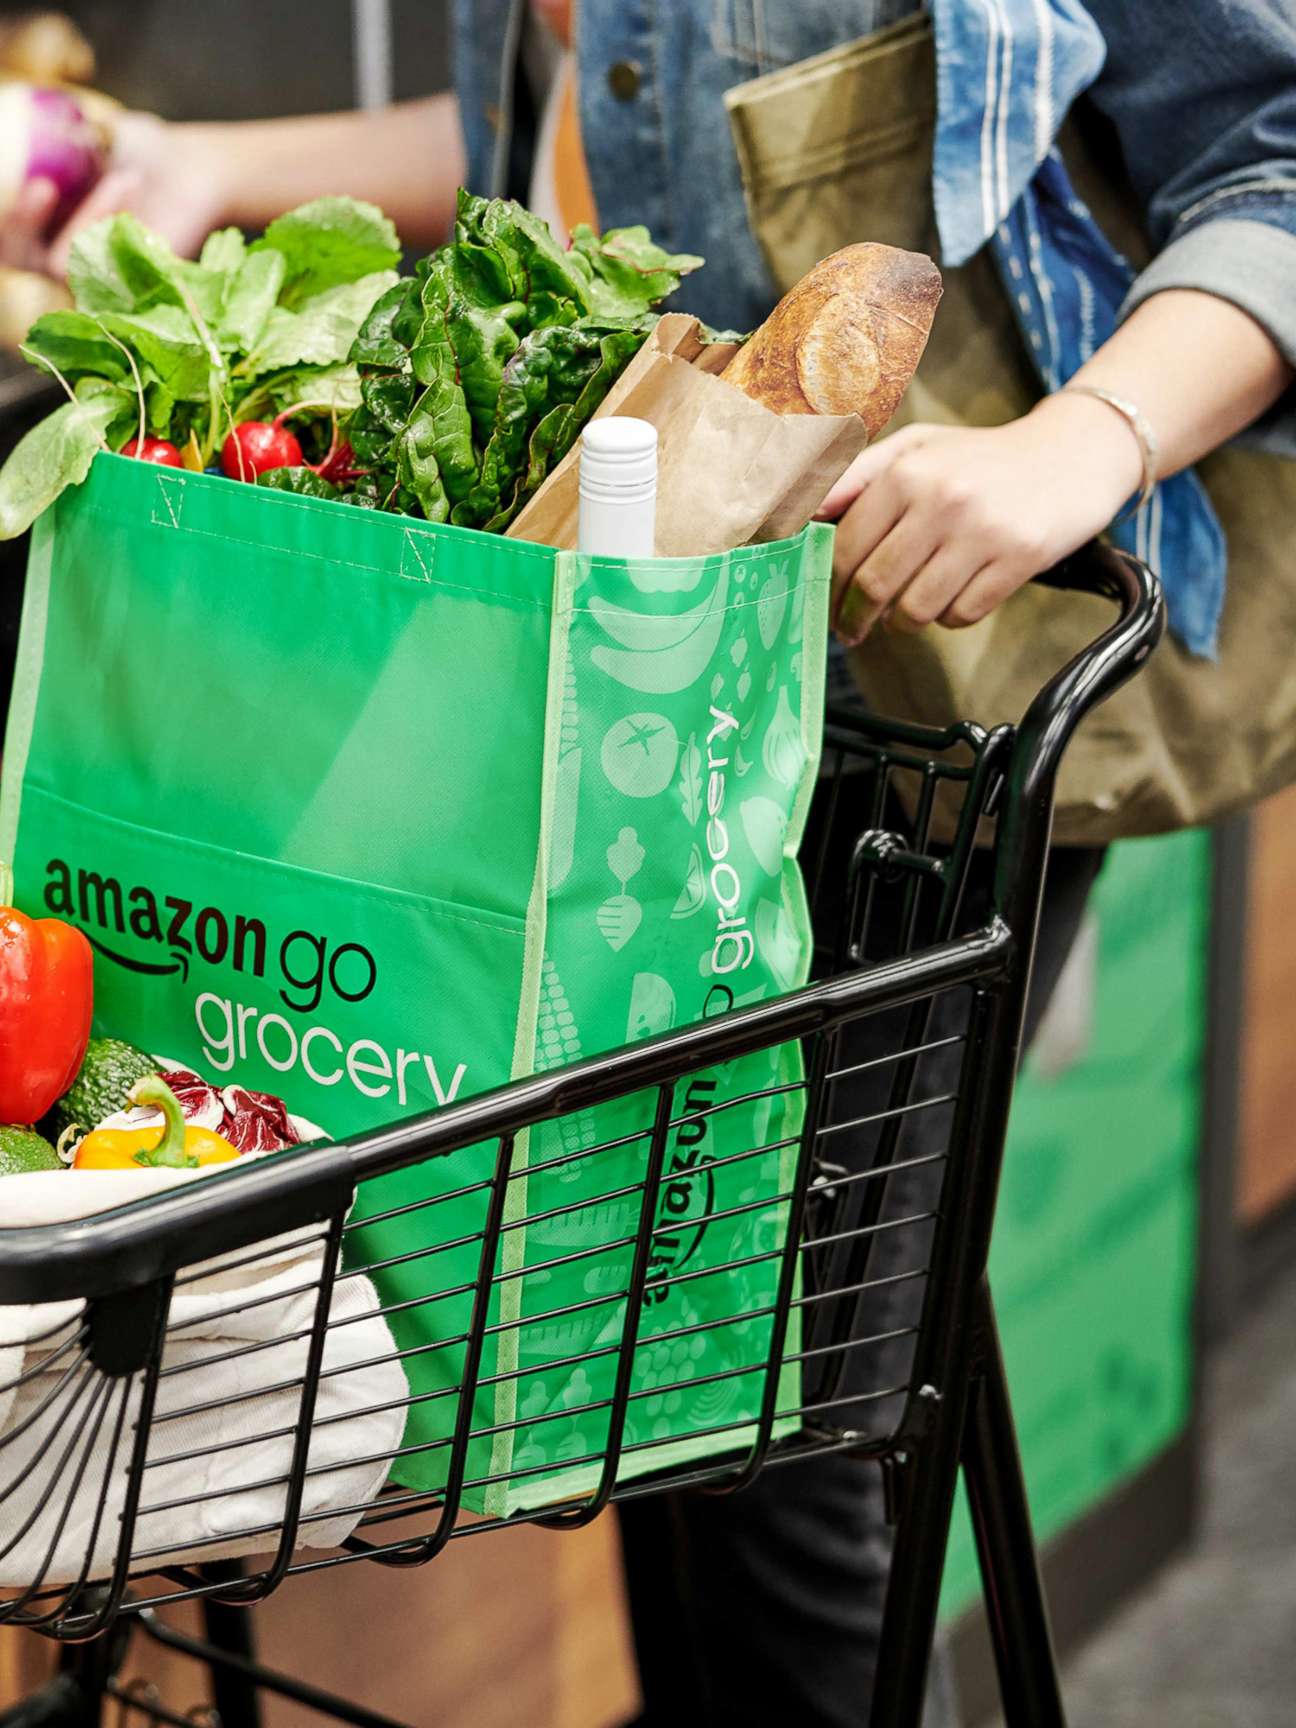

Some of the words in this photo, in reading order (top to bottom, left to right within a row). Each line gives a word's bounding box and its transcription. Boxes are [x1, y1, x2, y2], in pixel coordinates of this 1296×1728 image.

[706, 704, 754, 974] grocery
[43, 858, 267, 978] amazon
[279, 929, 377, 1013] go
[194, 992, 468, 1106] grocery
